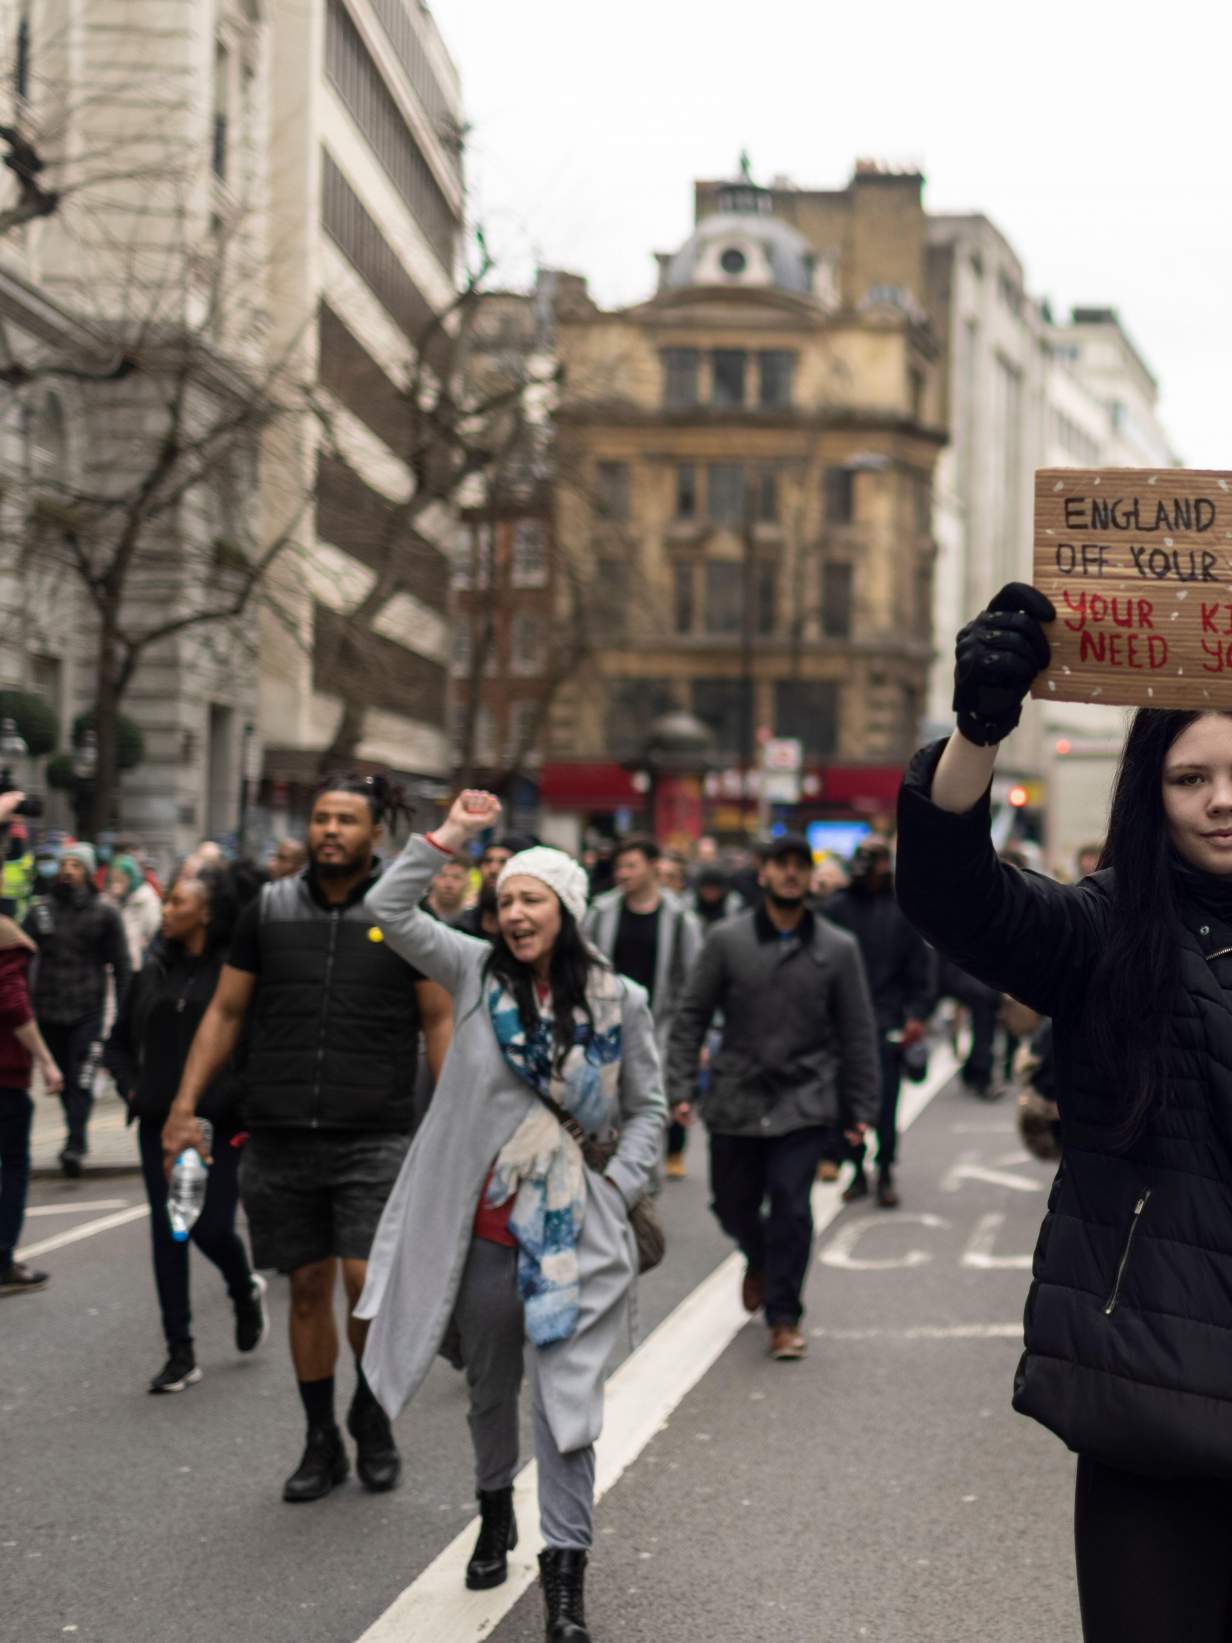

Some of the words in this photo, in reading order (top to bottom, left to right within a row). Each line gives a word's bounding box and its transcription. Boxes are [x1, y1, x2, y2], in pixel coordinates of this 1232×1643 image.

[1064, 497, 1216, 532] ENGLAND
[1055, 544, 1112, 576] OFF
[1130, 546, 1218, 582] YOUR
[1063, 590, 1154, 632] YOUR
[1080, 630, 1168, 669] NEED
